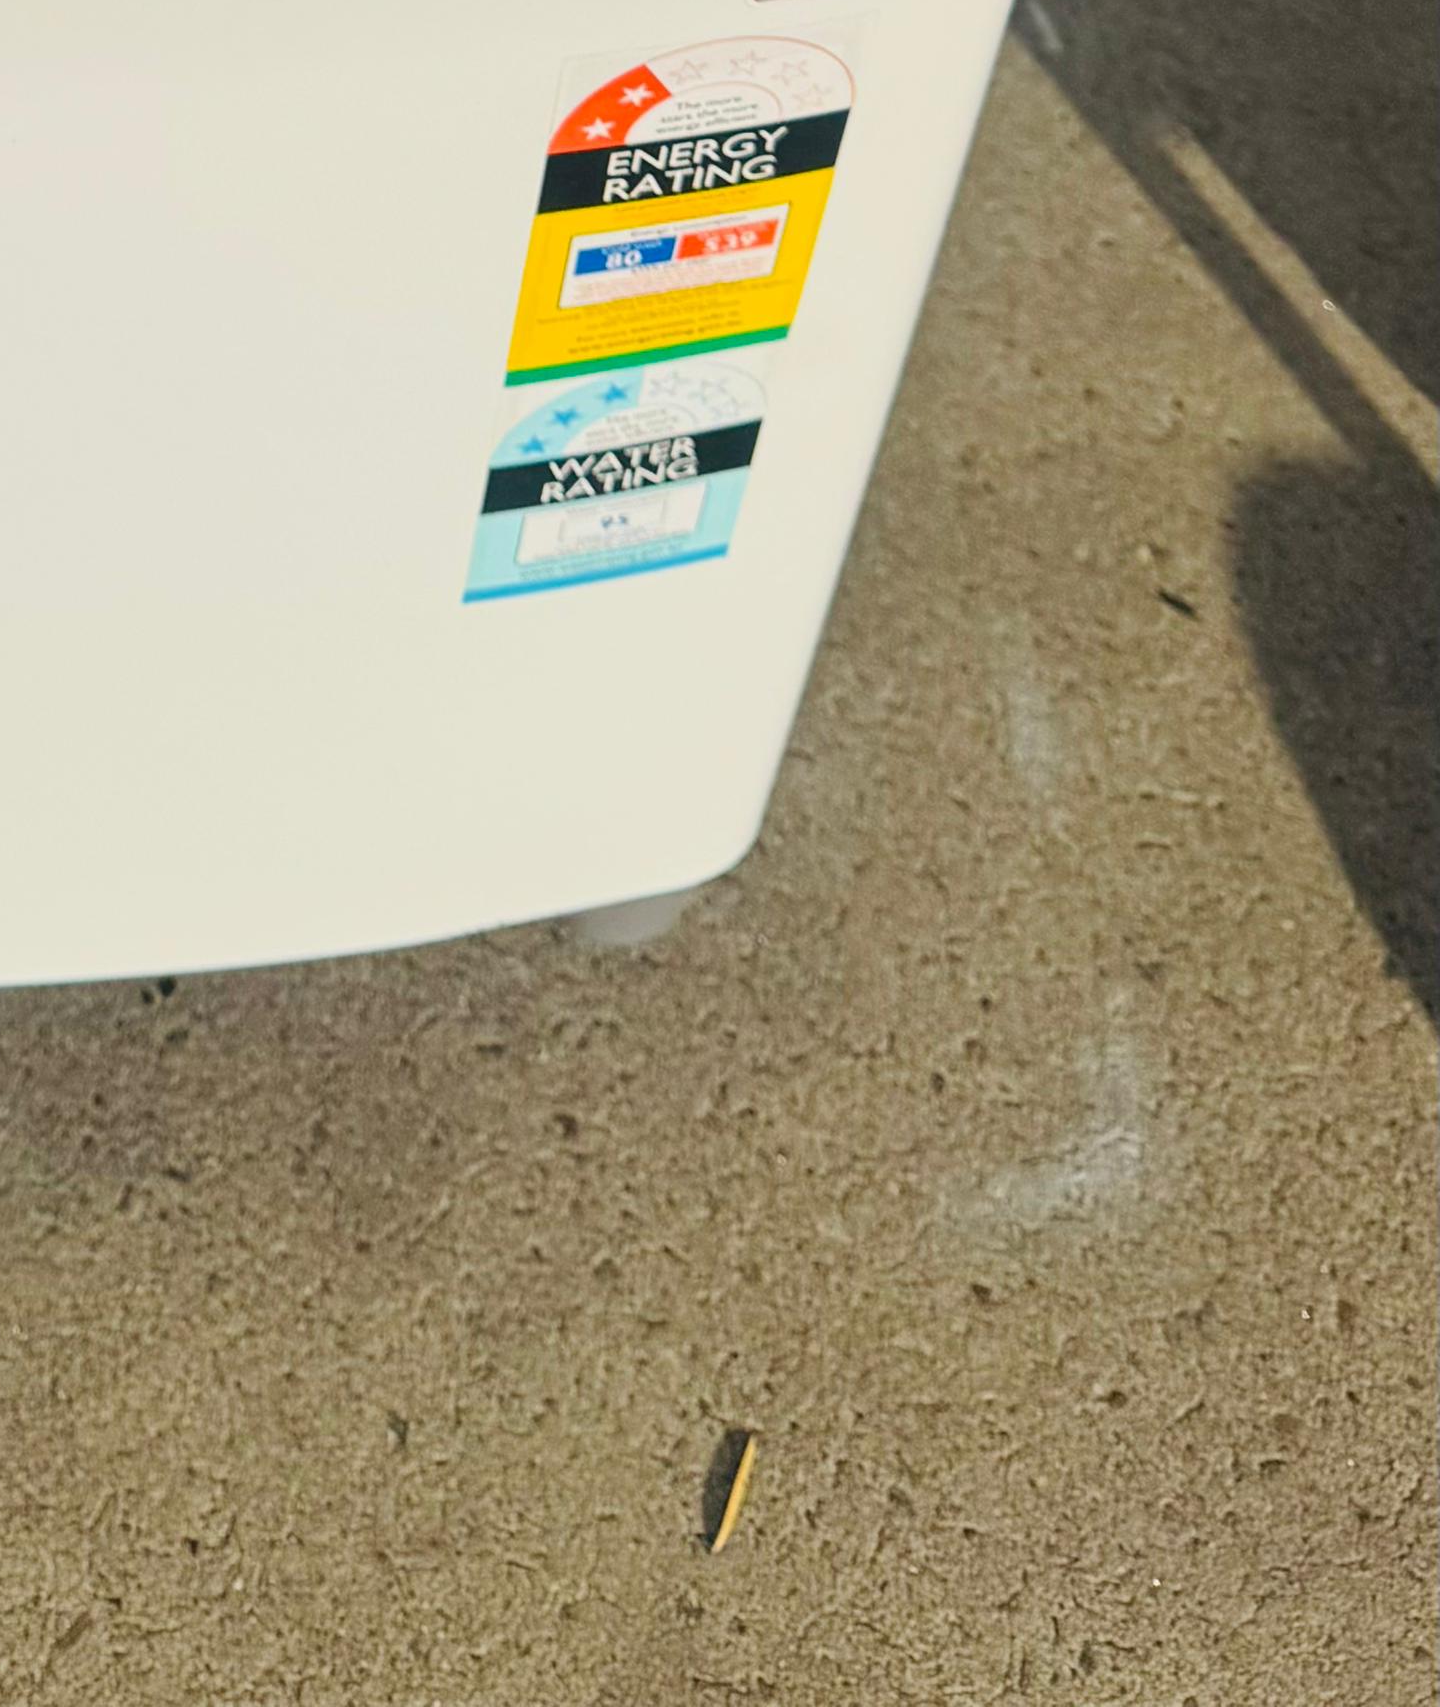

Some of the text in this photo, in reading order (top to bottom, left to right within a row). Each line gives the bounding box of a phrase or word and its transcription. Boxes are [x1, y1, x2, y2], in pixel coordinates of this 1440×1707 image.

[606, 125, 790, 179] ENERGY
[602, 153, 780, 204] RATING
[540, 455, 700, 505] RATING
[548, 435, 698, 482] WATER
